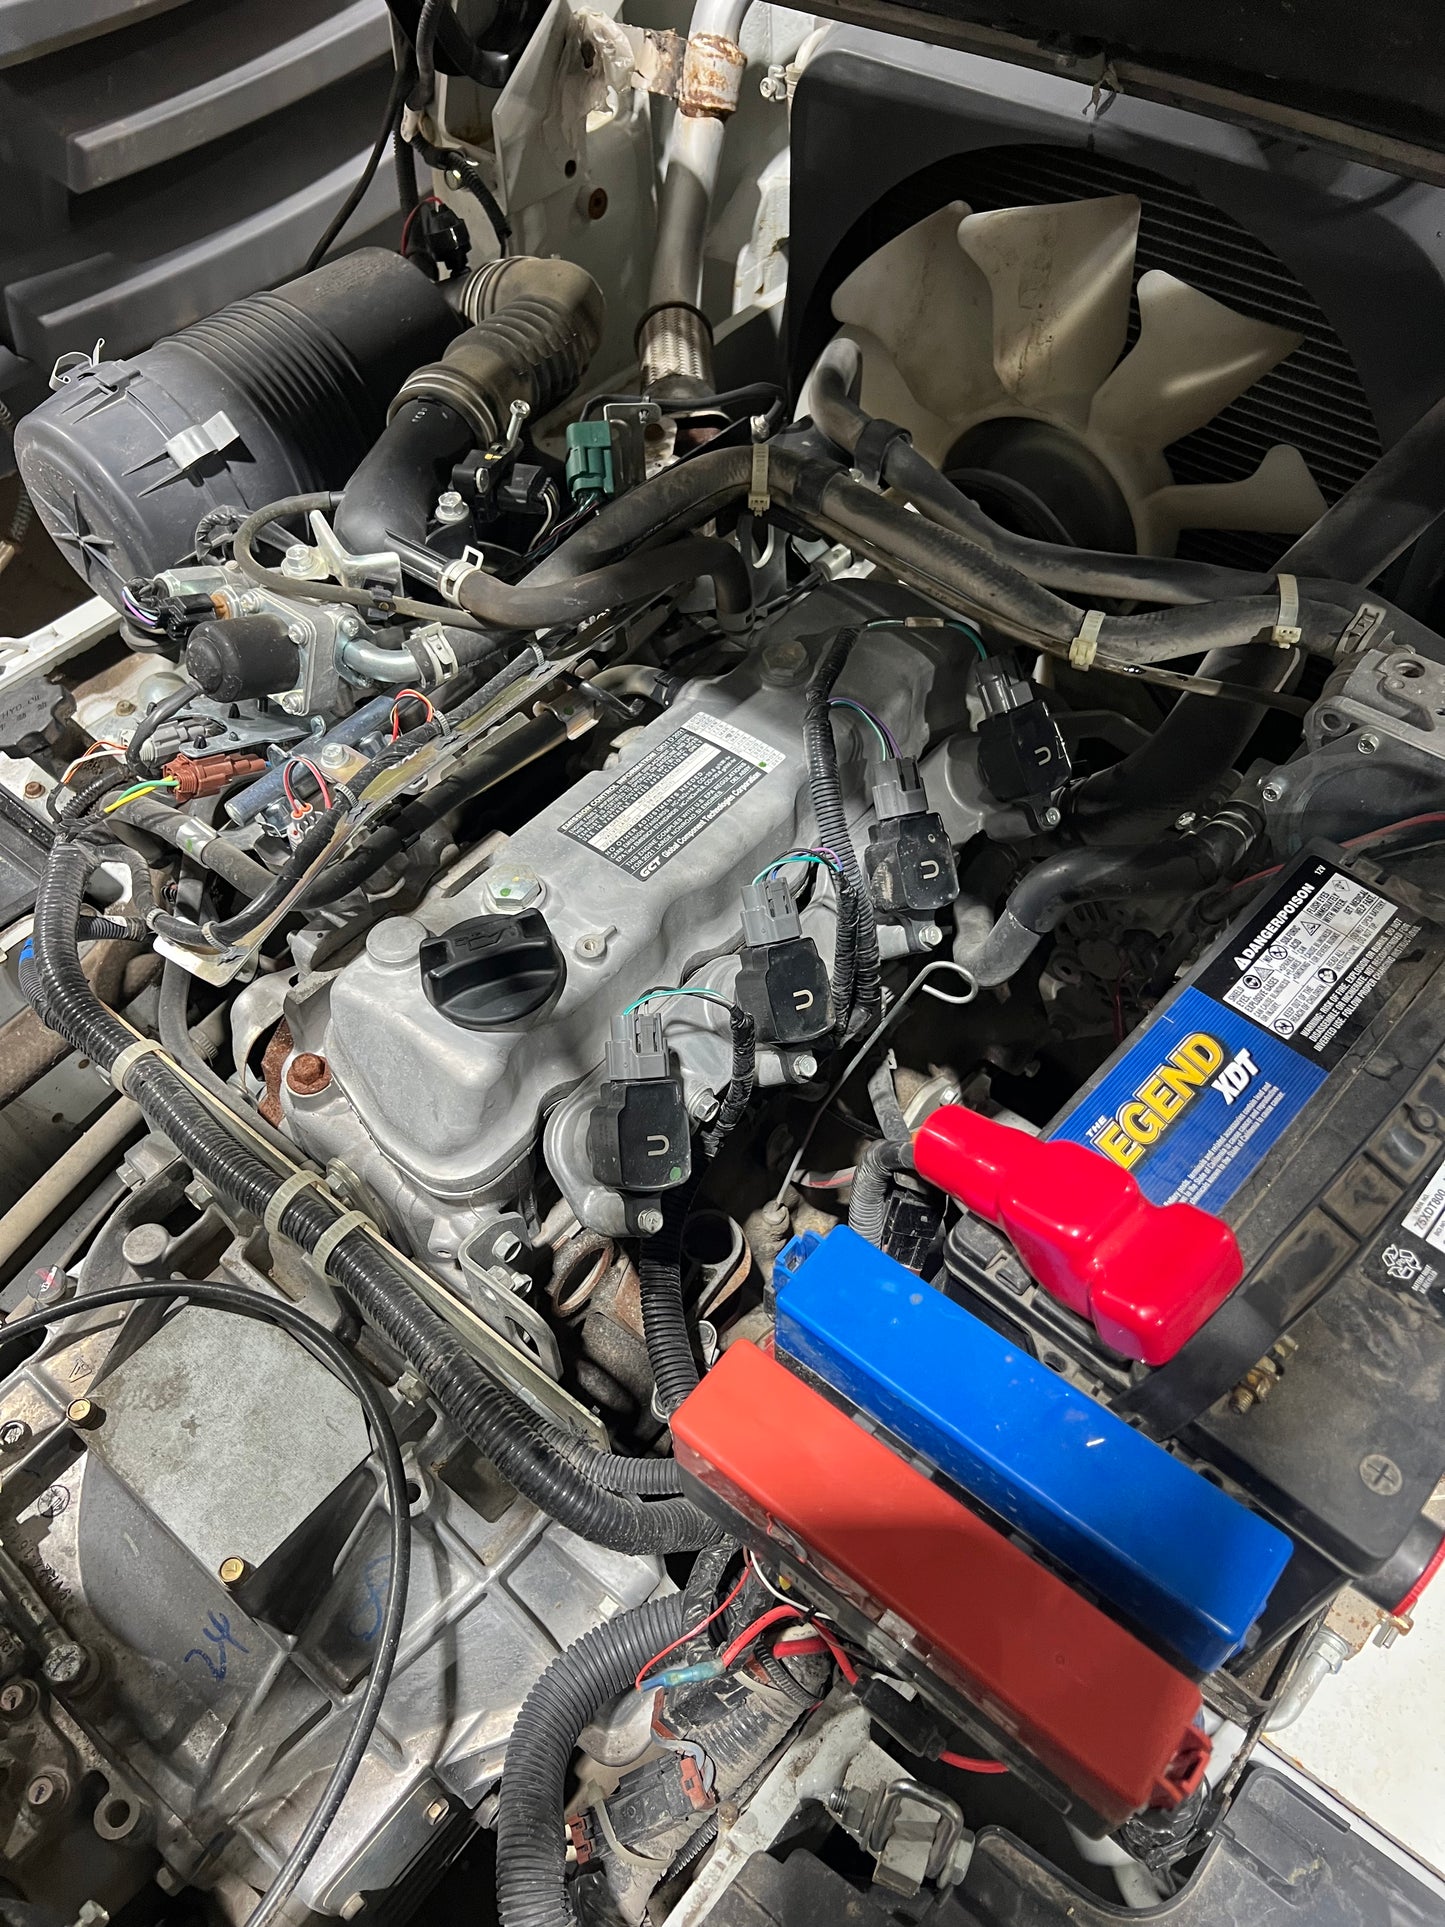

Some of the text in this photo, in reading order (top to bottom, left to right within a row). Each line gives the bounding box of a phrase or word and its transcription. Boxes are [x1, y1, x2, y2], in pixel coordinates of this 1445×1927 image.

[560, 804, 592, 830] EMISSION
[589, 783, 619, 806] CONTROL
[615, 751, 657, 784] INFORMATION
[624, 855, 639, 867] THIS
[636, 838, 658, 856] ENGINE
[655, 817, 683, 840] COMPLIES
[679, 805, 696, 818] WITH
[712, 761, 747, 790] REGULATIONS
[630, 859, 644, 870] FOR
[653, 833, 673, 850] LARGE
[670, 812, 697, 835] NONROAD
[637, 855, 665, 878] GCT
[659, 841, 681, 858] Global
[675, 818, 708, 845] Component
[701, 793, 738, 822] Technologies
[730, 770, 763, 796] Corporation
[921, 860, 939, 879] U
[1313, 864, 1327, 876] 12V
[1240, 882, 1316, 960] DANGER/POISON
[793, 990, 814, 1011] U
[1090, 1032, 1224, 1170] EGEND
[1210, 1047, 1260, 1105] XDT
[647, 1135, 670, 1156] U
[1085, 1114, 1107, 1137] THE
[1413, 1188, 1445, 1230] 75XDT800
[184, 1609, 249, 1681] 24
